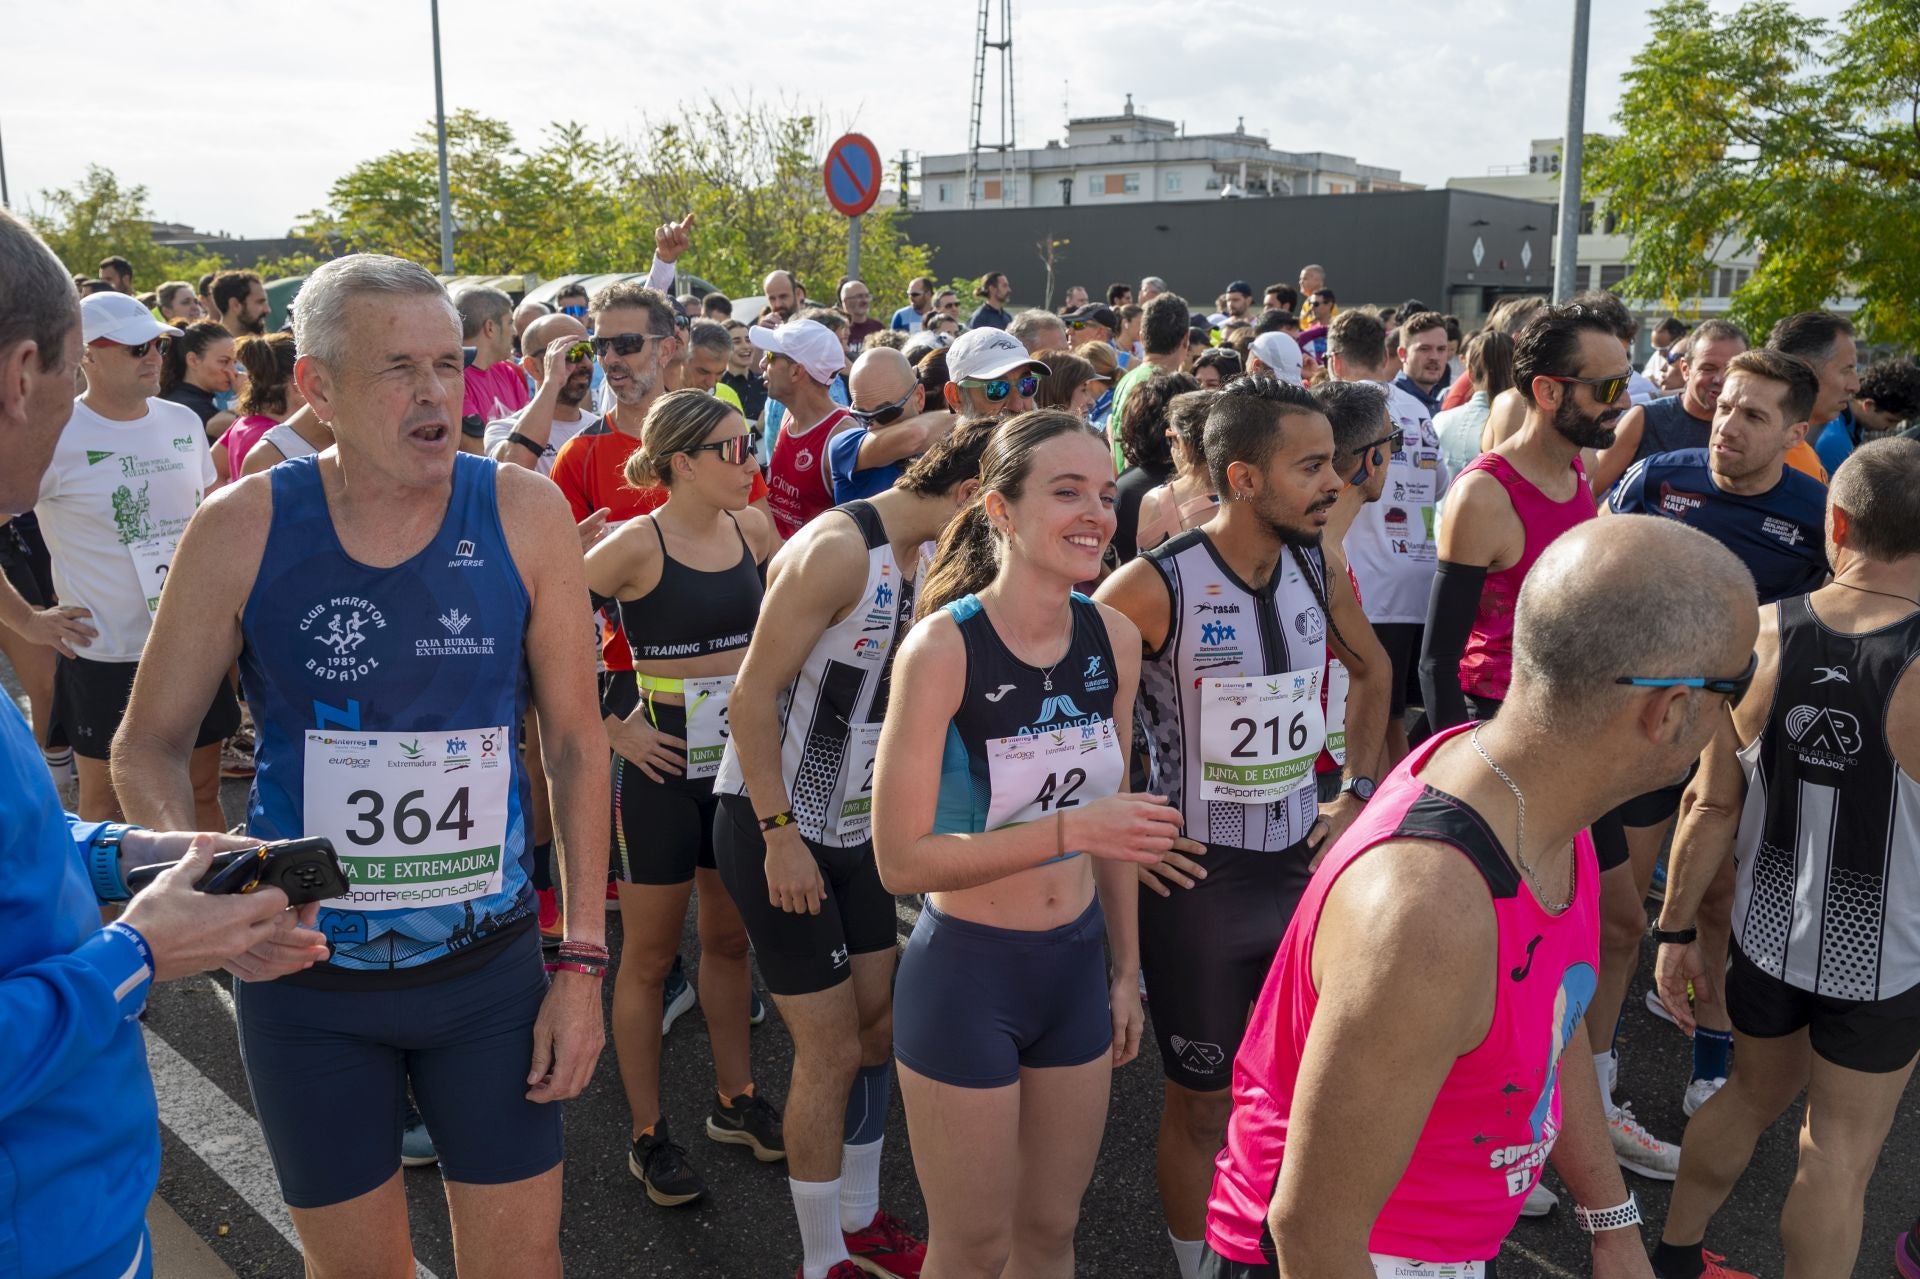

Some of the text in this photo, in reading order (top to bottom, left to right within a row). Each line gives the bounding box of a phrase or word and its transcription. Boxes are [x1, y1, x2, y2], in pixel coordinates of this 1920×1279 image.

[1663, 501, 1686, 512] HALF
[1665, 494, 1700, 508] #BERLIN
[448, 559, 484, 567] INVERSE
[300, 596, 387, 631] CLUB MARATON
[1213, 603, 1240, 614] rasán
[415, 637, 495, 648] CAJA RURAL DE
[643, 643, 700, 656] TRAINING
[708, 633, 748, 650] TRAINING
[415, 646, 495, 656] EXTREMADURA
[327, 657, 356, 666] 1989
[305, 657, 379, 682] BADAJOZ
[1230, 711, 1308, 758] 216
[692, 750, 715, 762] JUNTA
[1787, 743, 1858, 766] CLUB ATLETISMO
[387, 760, 437, 768] Extremadura
[1799, 753, 1845, 771] BADAJOZ
[1208, 766, 1239, 780] JUNTA
[1245, 770, 1258, 781] DE
[1035, 767, 1087, 812] 42
[346, 787, 474, 846] 364
[367, 863, 386, 878] DE
[394, 853, 495, 878] EXTREMADURA
[1395, 1267, 1435, 1277] Extremadura
